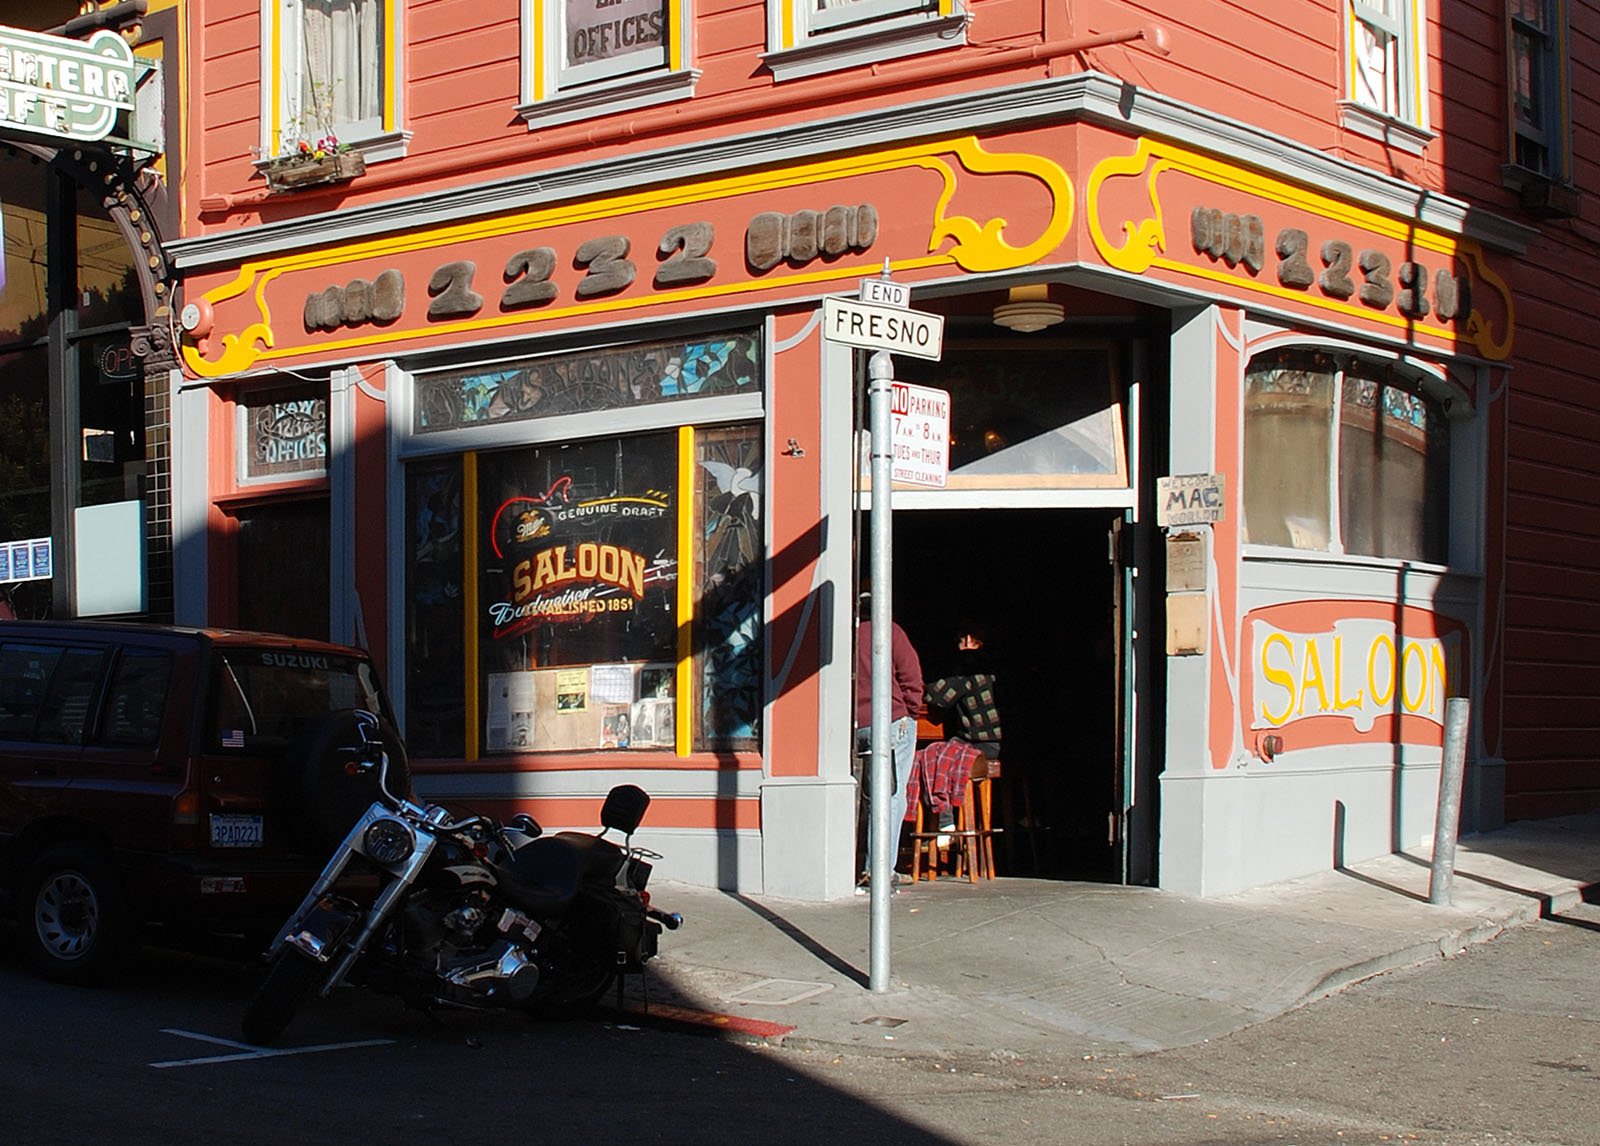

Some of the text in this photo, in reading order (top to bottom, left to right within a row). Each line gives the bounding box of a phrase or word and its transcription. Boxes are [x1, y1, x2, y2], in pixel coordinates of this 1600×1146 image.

[573, 11, 662, 58] OFFICES
[872, 285, 903, 303] END
[836, 309, 930, 346] FRESNO
[105, 348, 137, 373] OPE
[275, 400, 315, 420] LAW
[891, 385, 946, 419] NO PARKING
[895, 417, 902, 435] 7
[923, 422, 931, 440] 8
[266, 431, 326, 463] OFFICES
[894, 443, 910, 460] TUES
[922, 448, 942, 465] THUR
[894, 468, 943, 485] STREET CLEANING
[1161, 475, 1217, 488] WELCOME
[558, 503, 665, 520] GENUINE DRAFT
[513, 543, 645, 602] SALOON
[489, 587, 596, 626] Budweiser
[262, 653, 329, 669] SUZUKI
[1262, 632, 1457, 726] SALOON
[214, 826, 259, 844] 3PAD221
